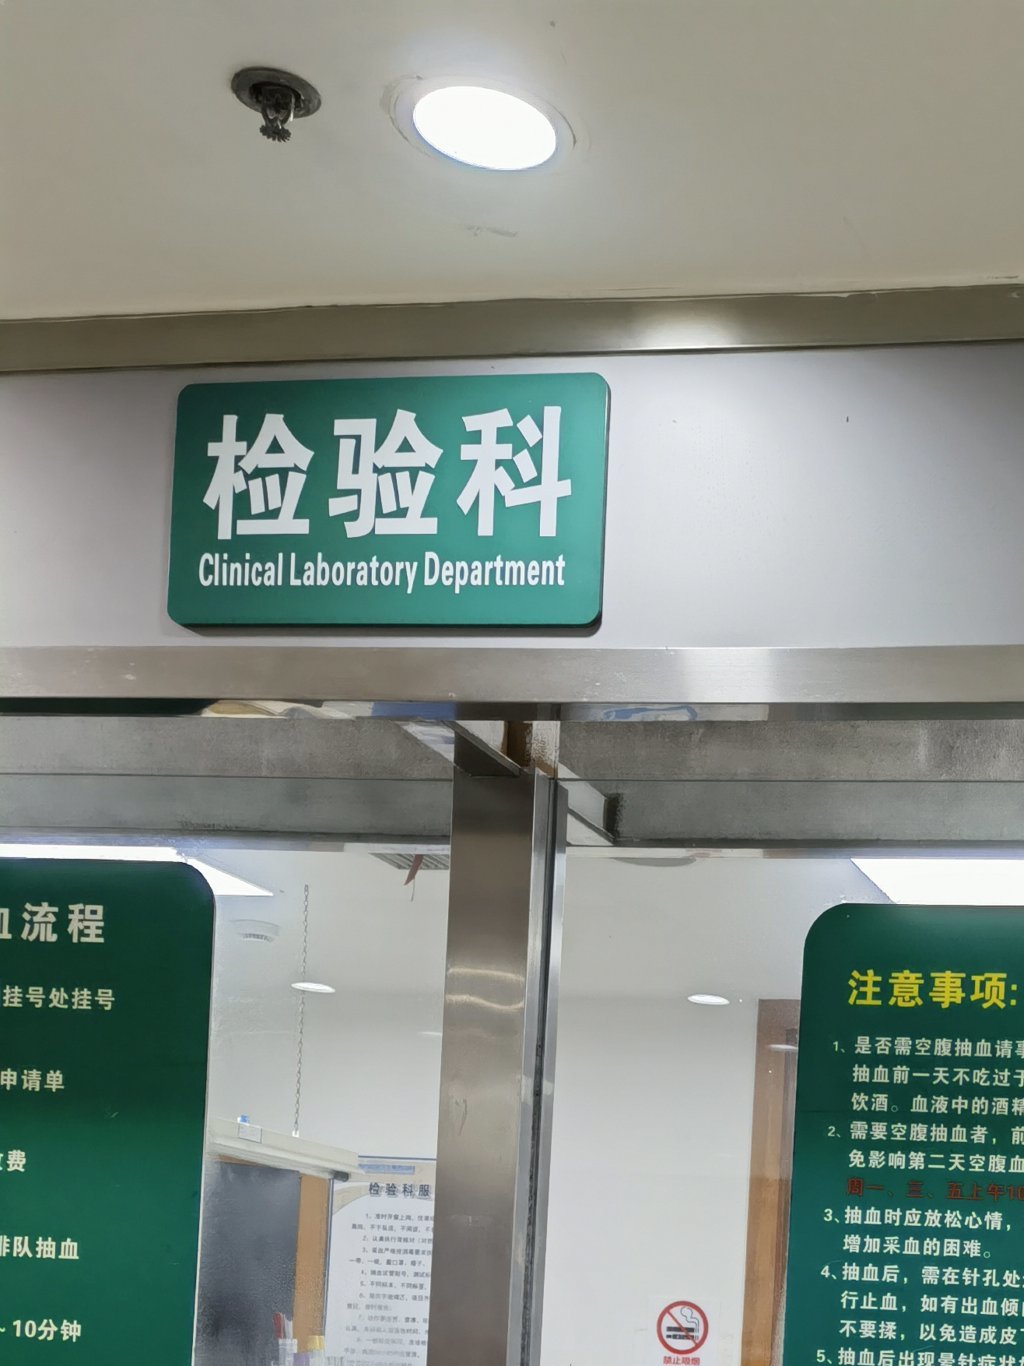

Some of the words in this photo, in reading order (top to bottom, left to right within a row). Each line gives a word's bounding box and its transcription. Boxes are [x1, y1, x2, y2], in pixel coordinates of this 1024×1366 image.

[203, 405, 572, 540] 检验科
[199, 553, 283, 586] Clinical
[290, 553, 417, 593] Laboratory
[424, 552, 565, 593] Department
[3, 985, 115, 1010] 挂号处挂号
[848, 968, 1017, 1009] 注意事项:
[0, 1068, 64, 1093] 申请单
[0, 1149, 26, 1172] 费
[843, 1234, 990, 1258] 增加采血的困难。
